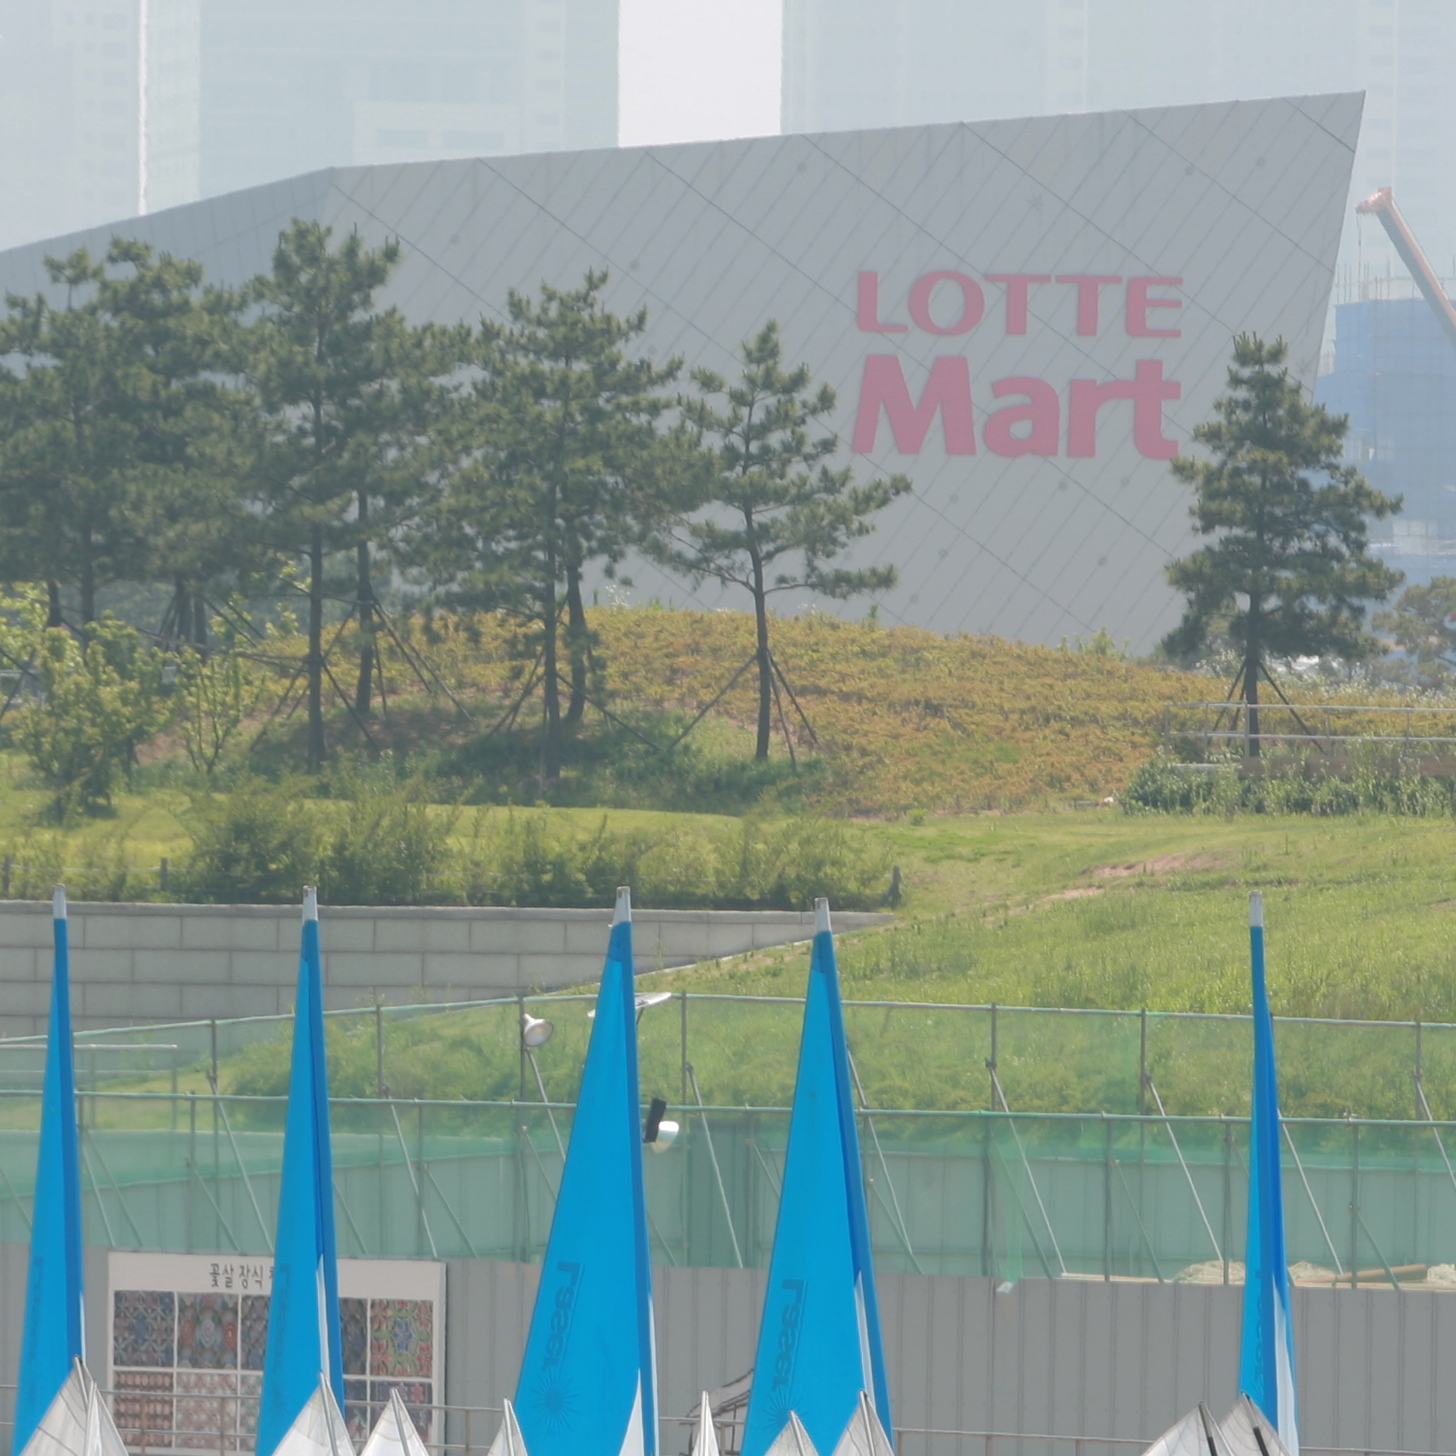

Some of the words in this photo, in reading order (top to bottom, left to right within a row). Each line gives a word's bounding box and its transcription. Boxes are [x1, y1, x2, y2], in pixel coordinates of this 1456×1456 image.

[856, 271, 1183, 338] LOTTE
[851, 354, 1181, 460] Mart
[239, 1264, 264, 1290] 장식
